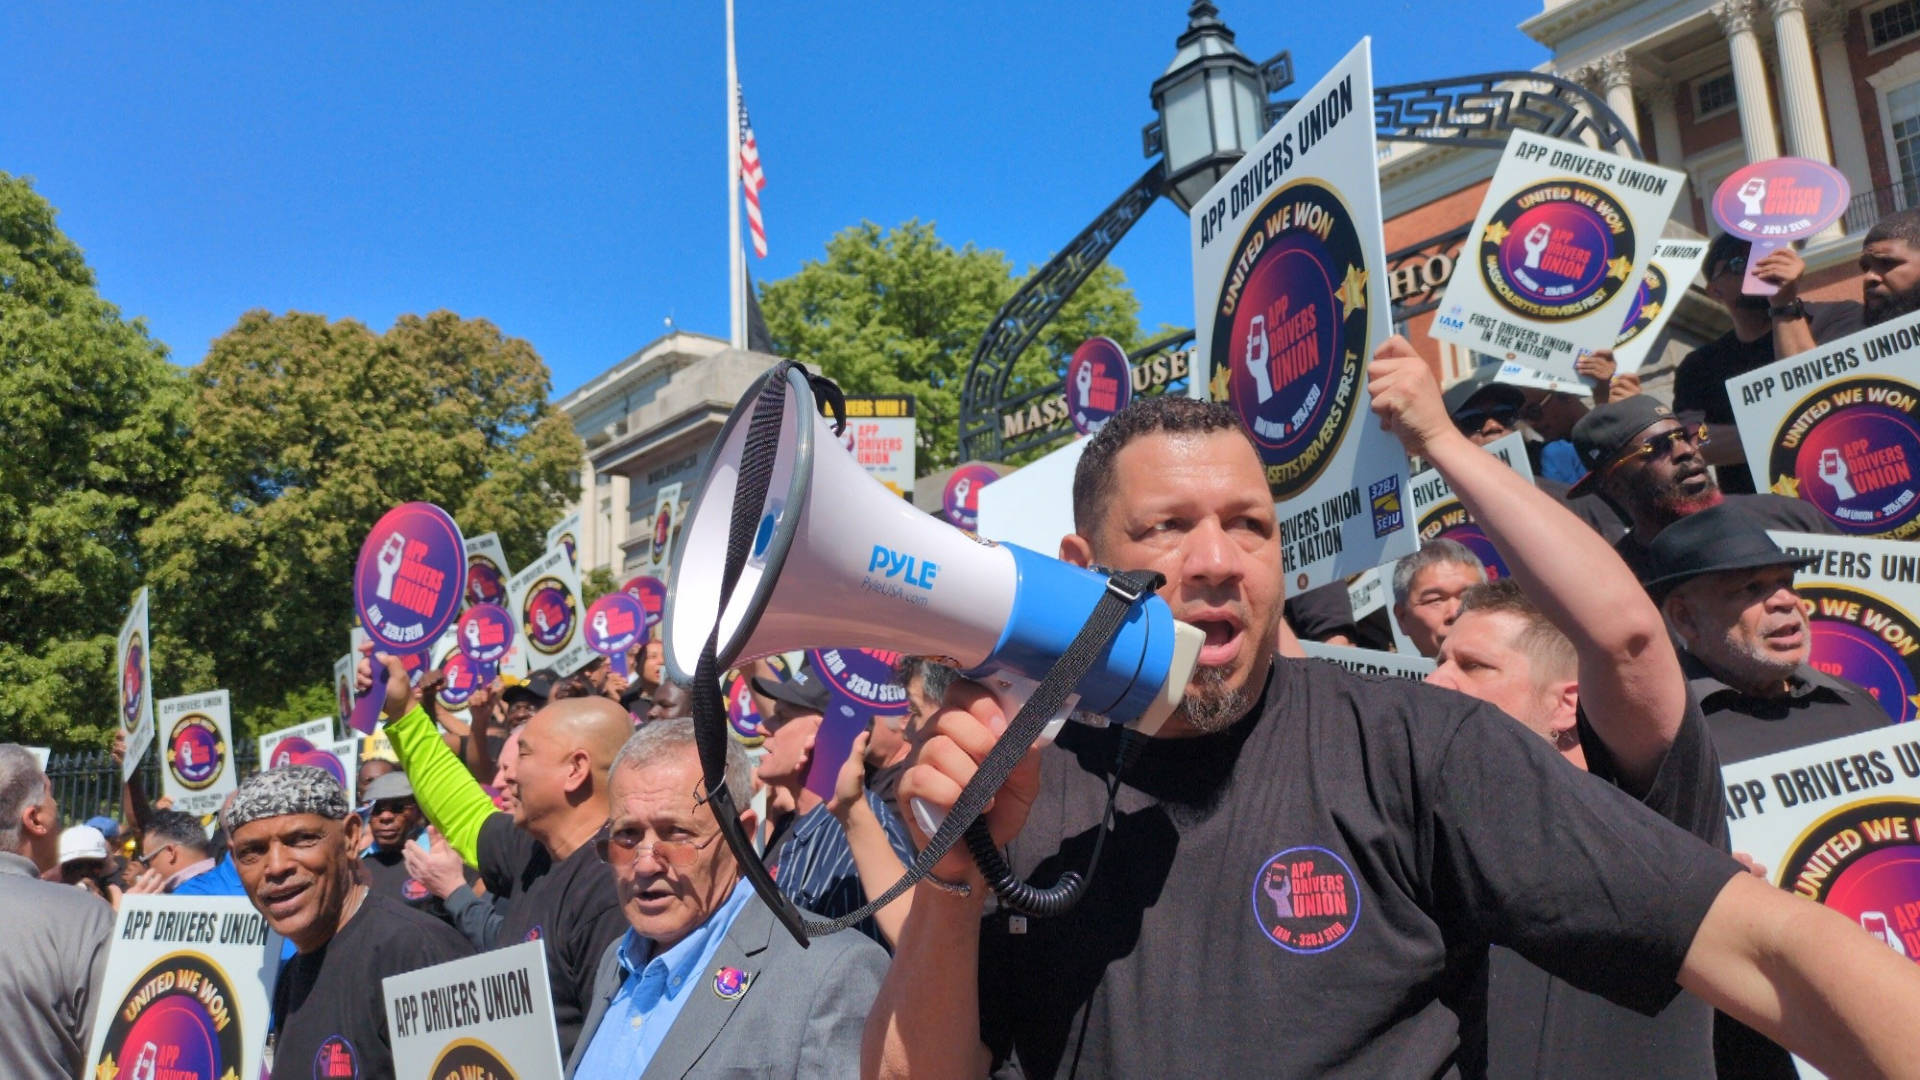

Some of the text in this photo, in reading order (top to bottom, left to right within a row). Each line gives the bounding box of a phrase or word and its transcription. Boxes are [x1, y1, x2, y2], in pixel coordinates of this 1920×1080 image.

[1201, 74, 1353, 248] APP DRIVERS UNION
[1515, 141, 1668, 197] APP DRIVERS UNION
[1517, 187, 1572, 209] UNITED
[1573, 189, 1599, 207] WE
[1222, 201, 1335, 316] UNITED WE WON
[1541, 255, 1585, 281] UNION
[1661, 245, 1702, 260] UNION
[1268, 294, 1289, 333] APP
[1438, 316, 1465, 331] IAM
[1004, 395, 1069, 439] MASS
[1132, 350, 1189, 391] USE
[1388, 253, 1453, 301] HO
[1269, 303, 1317, 360] DRIVERS
[1469, 313, 1498, 330] FIRST
[1499, 321, 1541, 344] DRIVERS
[1542, 335, 1574, 354] UNION
[1480, 328, 1492, 342] IN
[1495, 332, 1513, 349] THE
[1514, 340, 1554, 360] NATION
[1271, 331, 1320, 392] UNION
[1335, 348, 1359, 408] FIRST
[1741, 376, 1775, 406] APP
[1780, 347, 1859, 393] DRIVERS
[1783, 386, 1918, 449] UNITED WE WON
[857, 437, 903, 452] DRIVERS
[857, 452, 890, 464] UNION
[1843, 438, 1869, 459] APP
[1849, 444, 1905, 475] DRIVERS
[1370, 477, 1397, 500] 32BJ
[1853, 461, 1911, 494] UNION
[1280, 486, 1362, 548] RIVERS UNION
[1376, 512, 1400, 532] SEIU
[1441, 508, 1466, 527] WE
[404, 538, 429, 563] APP
[1281, 526, 1343, 574] HE NATION
[400, 557, 446, 594] DRIVERS
[860, 575, 929, 609] PyleUSA.com
[391, 576, 440, 619] UNION
[1820, 597, 1862, 621] WE
[1863, 608, 1920, 657] WON
[846, 672, 878, 700] 32BJ
[1771, 749, 1895, 808] DRIVERS
[1291, 860, 1315, 879] APP
[1793, 828, 1863, 903] UNITED
[1858, 816, 1910, 843] WE
[1292, 874, 1345, 894] DRIVERS
[1293, 893, 1348, 918] UNION
[122, 910, 271, 946] APP DRIVERS UNION
[1299, 931, 1325, 946] 32BJ
[1323, 921, 1346, 943] SEIU
[124, 969, 232, 1032] UNITED WE WON
[394, 967, 534, 1038] APP DRIVERS UNION
[158, 1044, 181, 1068] APP
